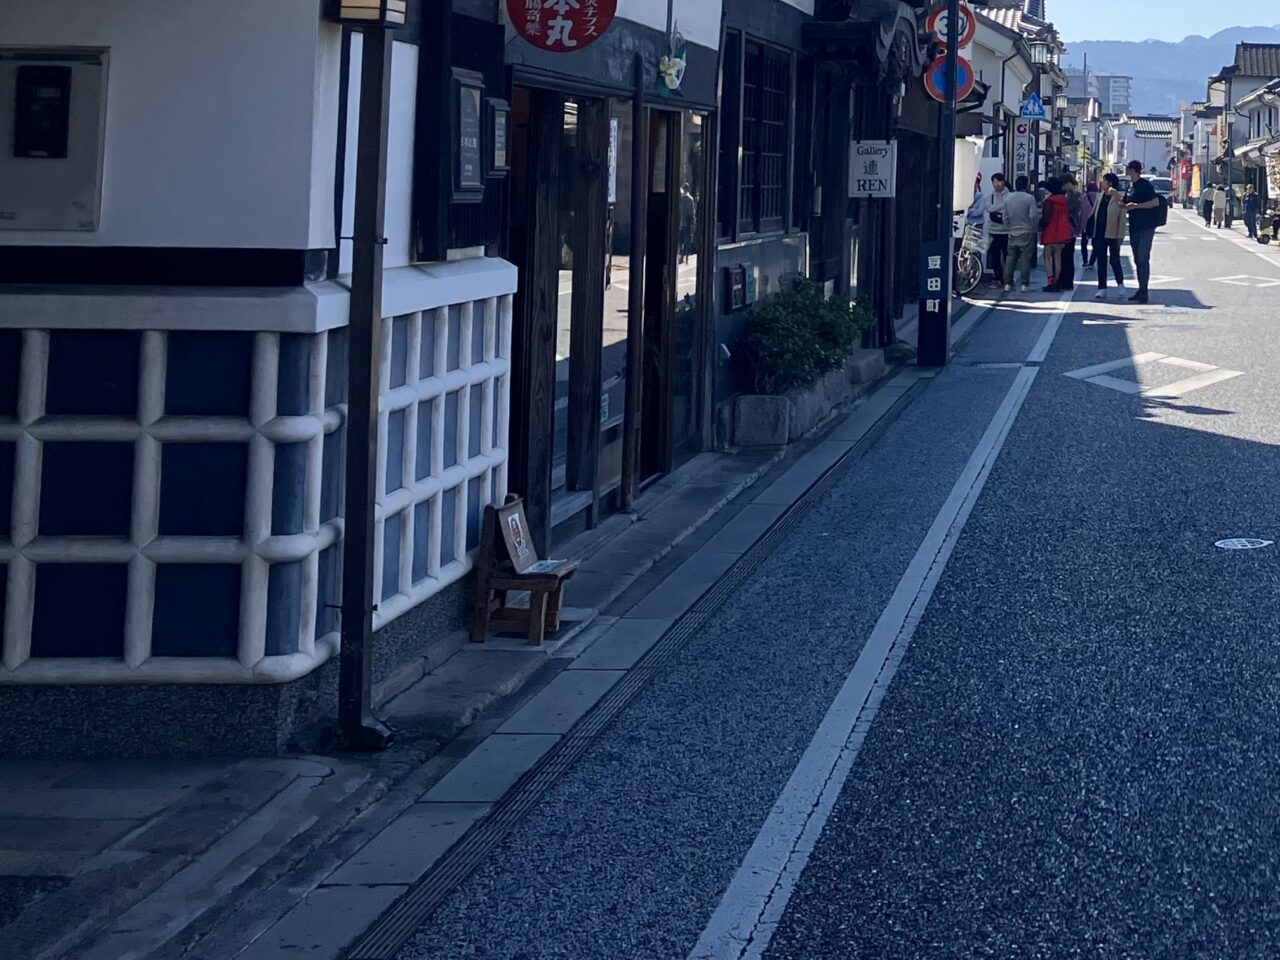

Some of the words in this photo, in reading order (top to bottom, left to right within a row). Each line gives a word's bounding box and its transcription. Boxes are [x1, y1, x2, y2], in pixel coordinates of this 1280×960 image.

[857, 145, 889, 159] Gallery
[1016, 142, 1026, 176] 大分銀
[856, 179, 888, 192] REN
[926, 255, 942, 313] 豆田町
